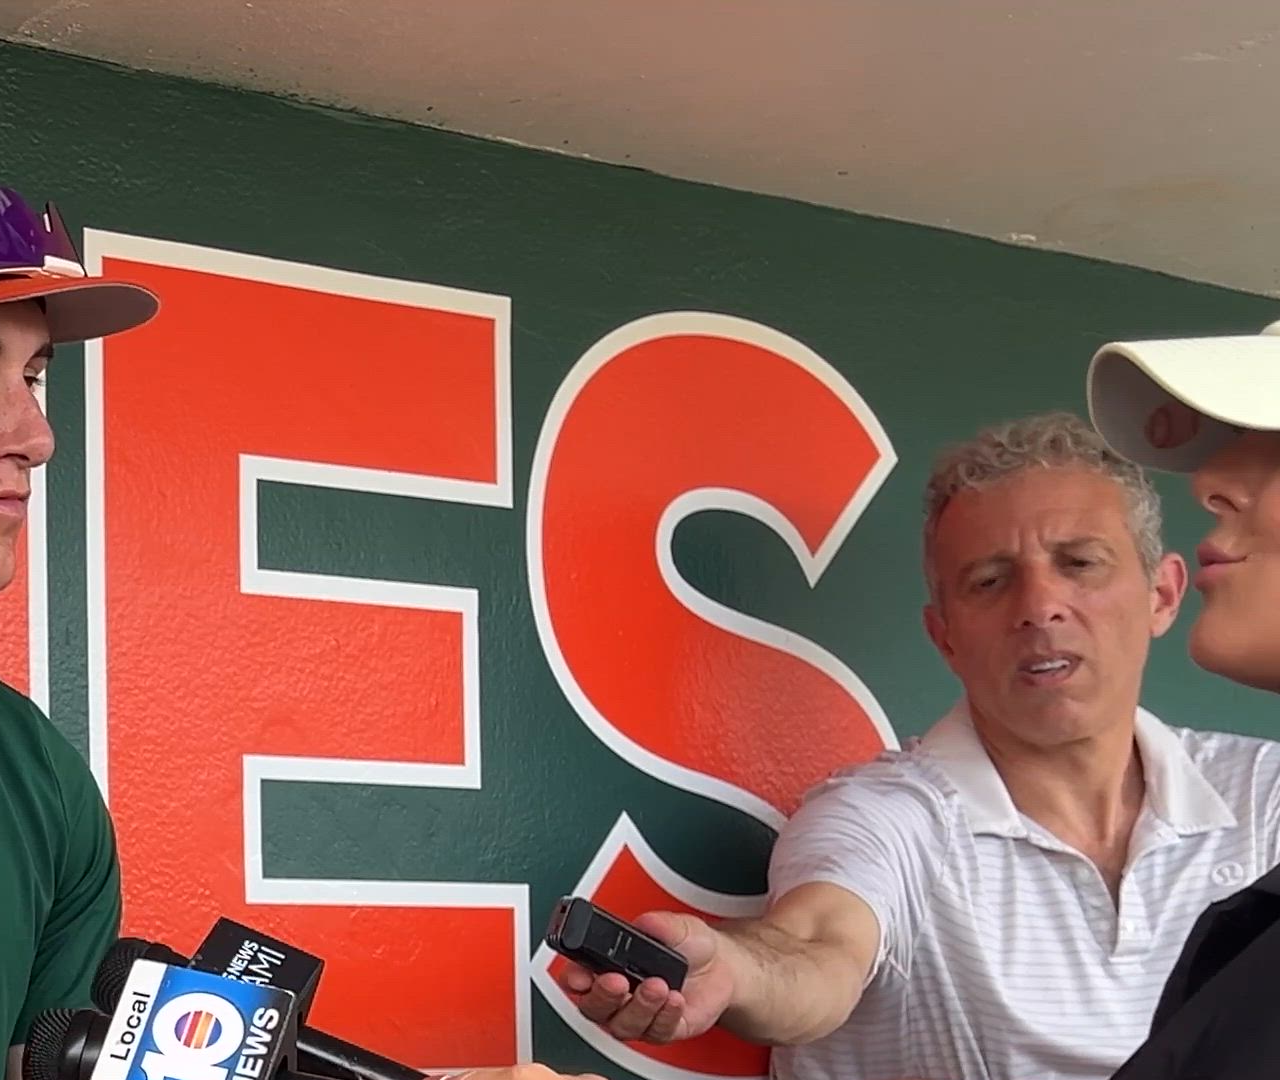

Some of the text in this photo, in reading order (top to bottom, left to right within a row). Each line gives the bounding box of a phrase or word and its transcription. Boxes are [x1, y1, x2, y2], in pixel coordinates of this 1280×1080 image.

[226, 940, 259, 977] NEWS
[240, 946, 286, 986] AMI
[110, 990, 151, 1061] Local
